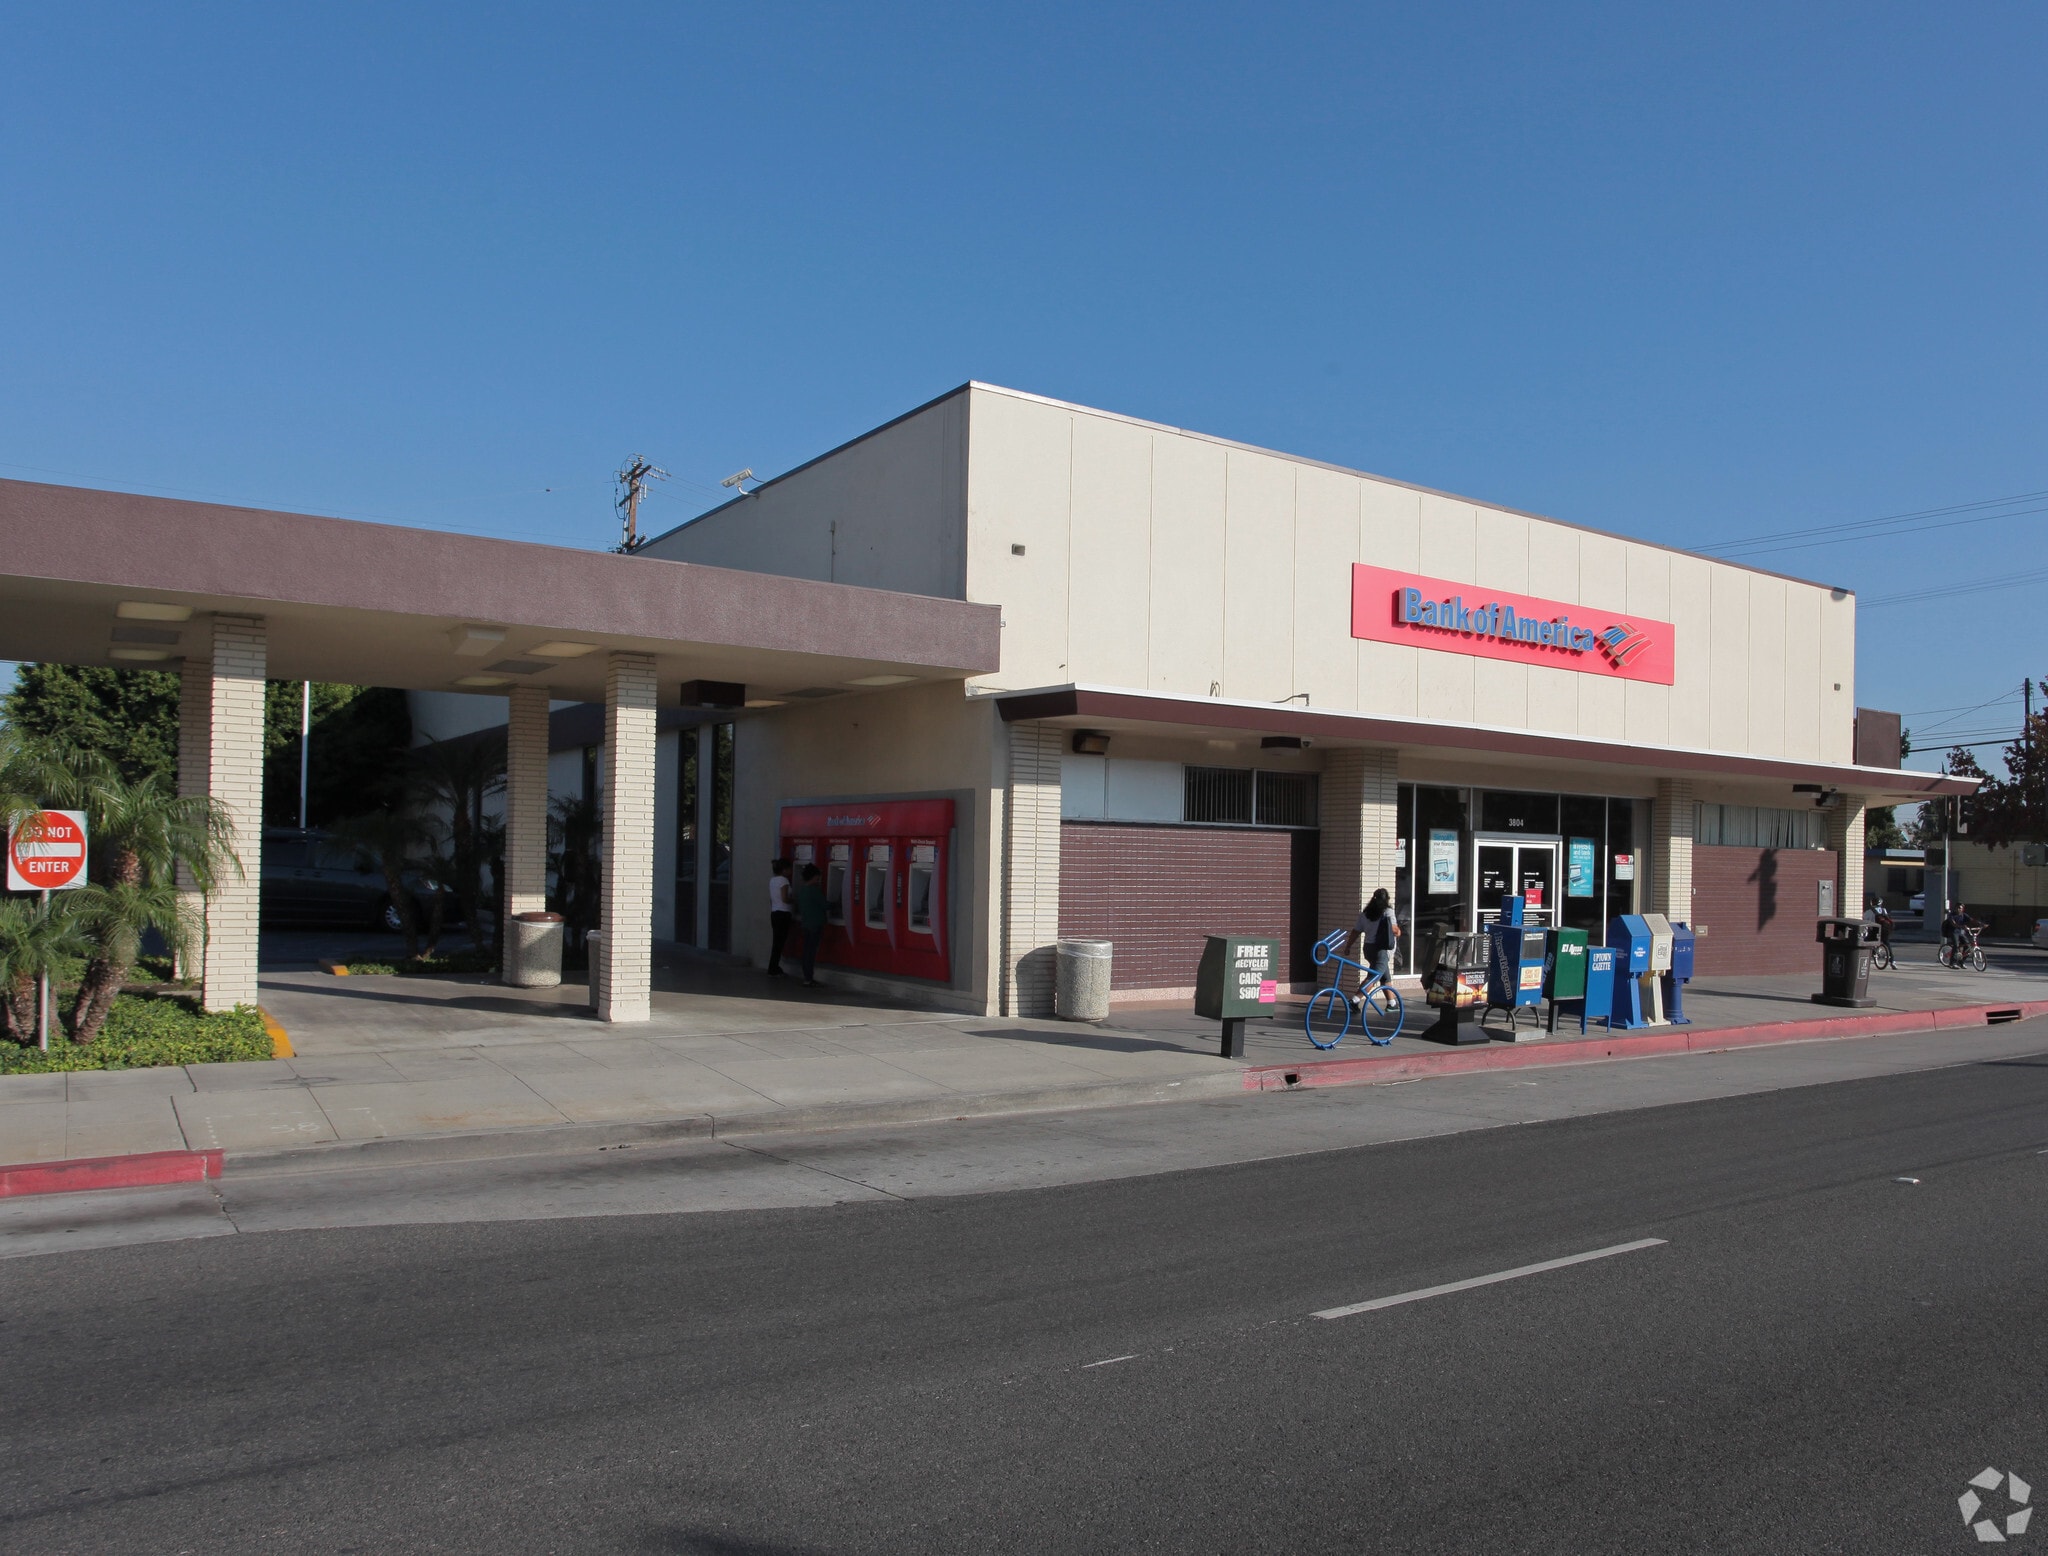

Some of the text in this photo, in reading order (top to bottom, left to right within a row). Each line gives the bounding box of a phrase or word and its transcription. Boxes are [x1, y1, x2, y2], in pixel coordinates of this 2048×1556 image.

[1400, 587, 1594, 651] Bank of America
[1508, 818, 1525, 827] 3804
[47, 826, 72, 838] NOT
[29, 861, 69, 873] ENTER
[1237, 945, 1268, 958] FREE
[1592, 952, 1612, 962] UPTOWN
[1235, 958, 1269, 968] RECYCLER
[1239, 972, 1262, 985] CARS
[1239, 986, 1261, 1000] JOBS
